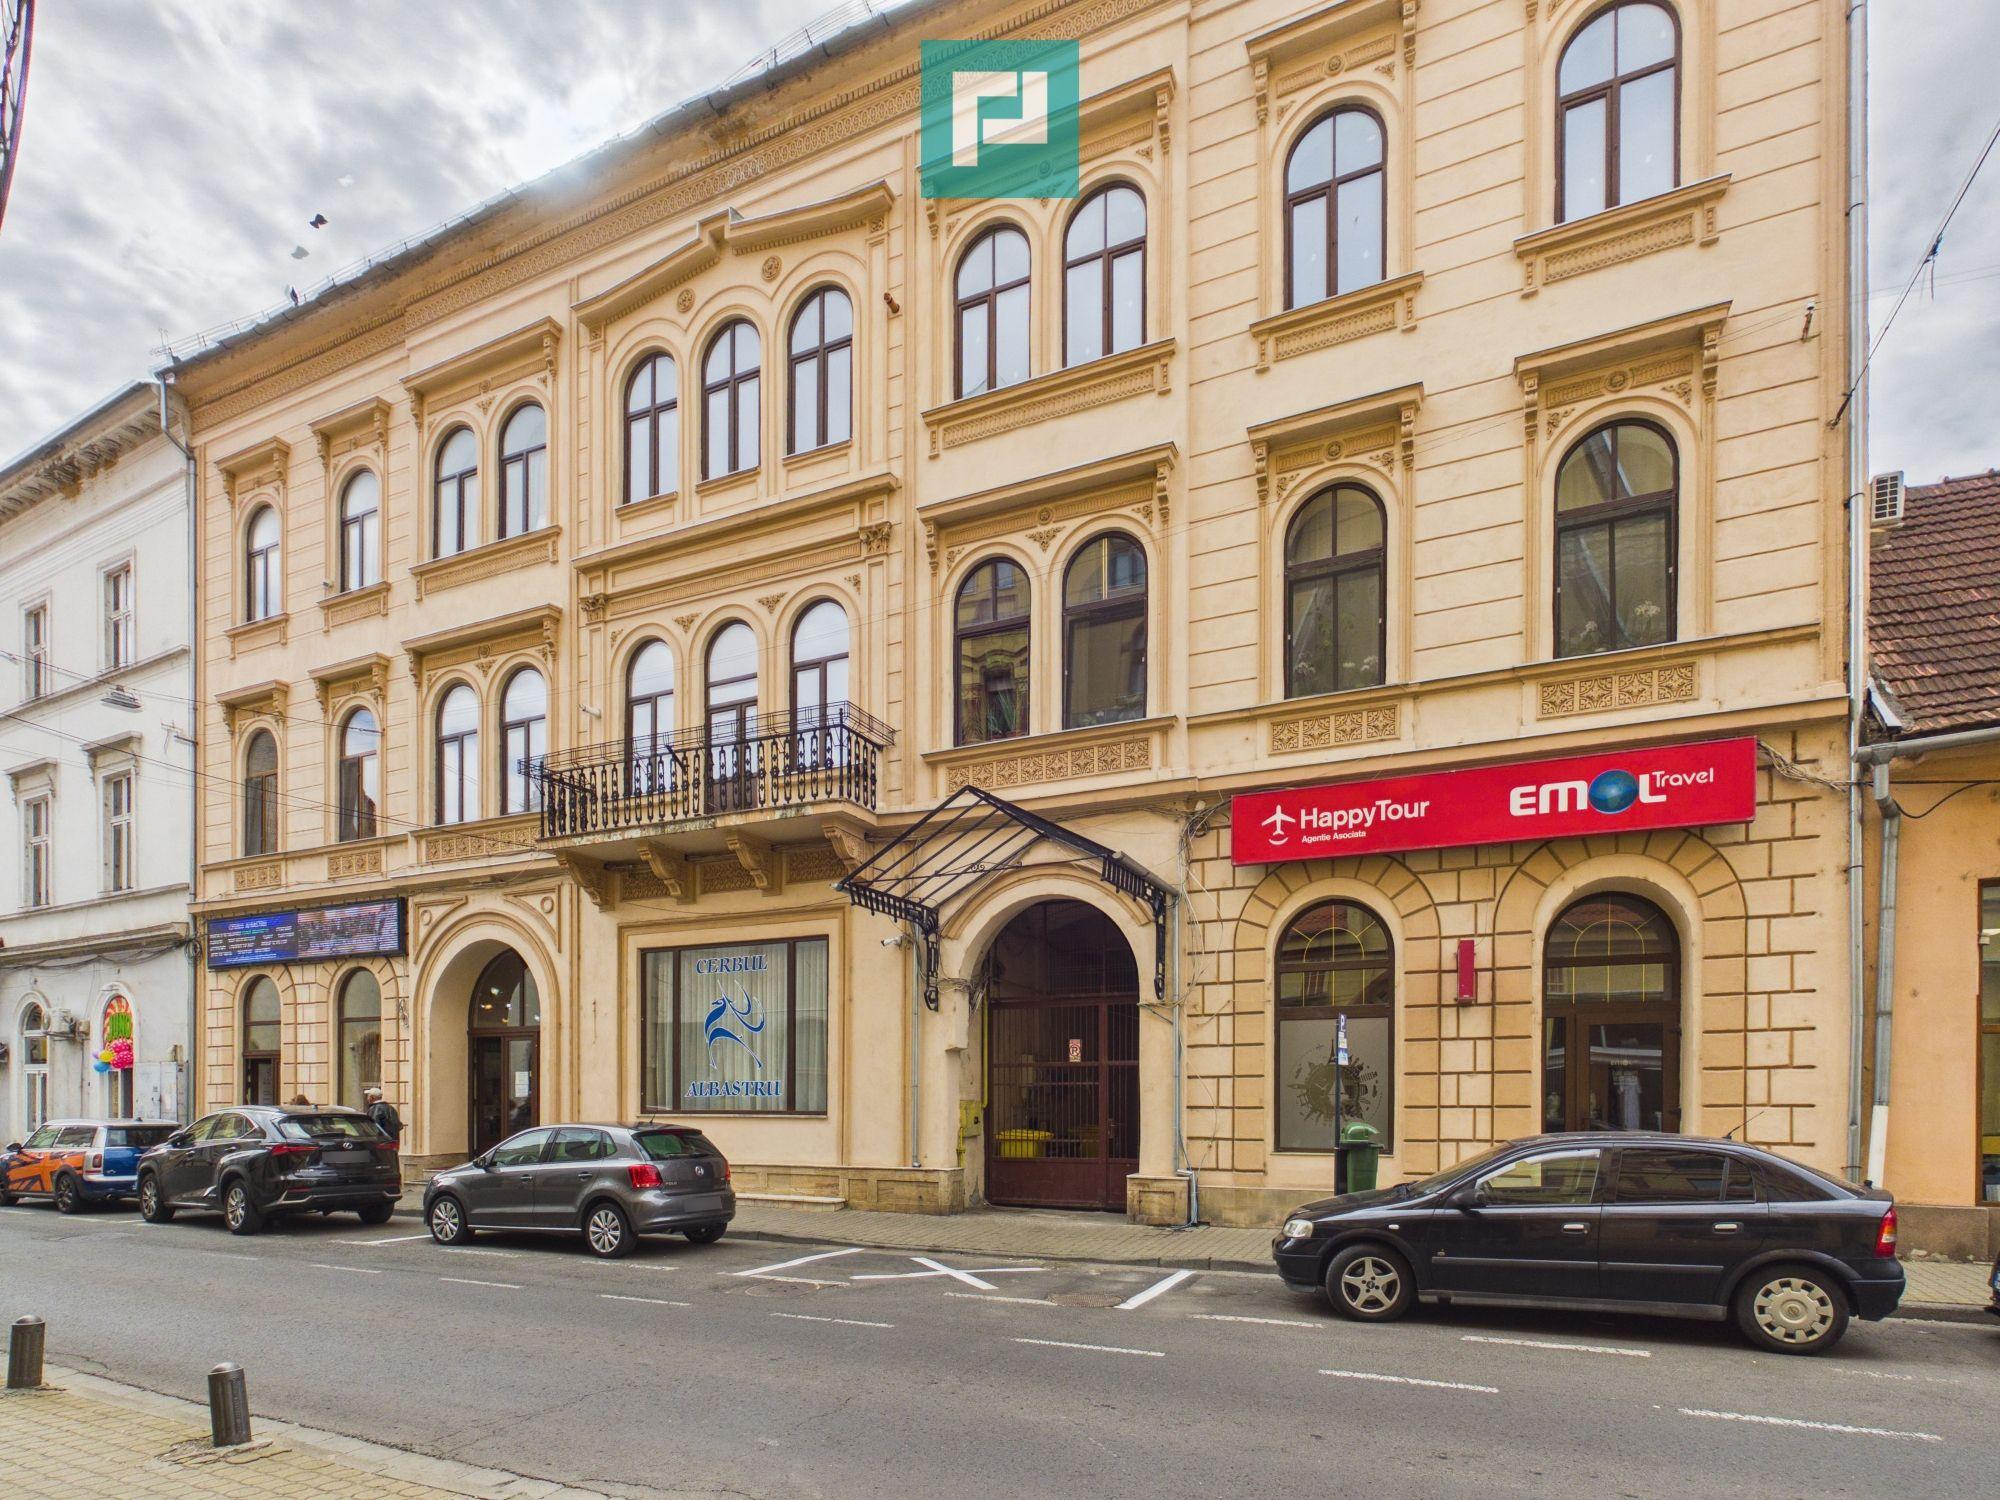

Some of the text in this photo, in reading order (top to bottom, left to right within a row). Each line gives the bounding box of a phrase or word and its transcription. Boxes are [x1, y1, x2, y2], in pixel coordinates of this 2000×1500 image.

[1652, 767, 1714, 788] Travel
[1300, 799, 1430, 831] HappyTour
[1301, 830, 1367, 844] Agentie Asociata
[696, 954, 768, 975] CERBUL
[685, 1080, 783, 1098] ALBASTRU
